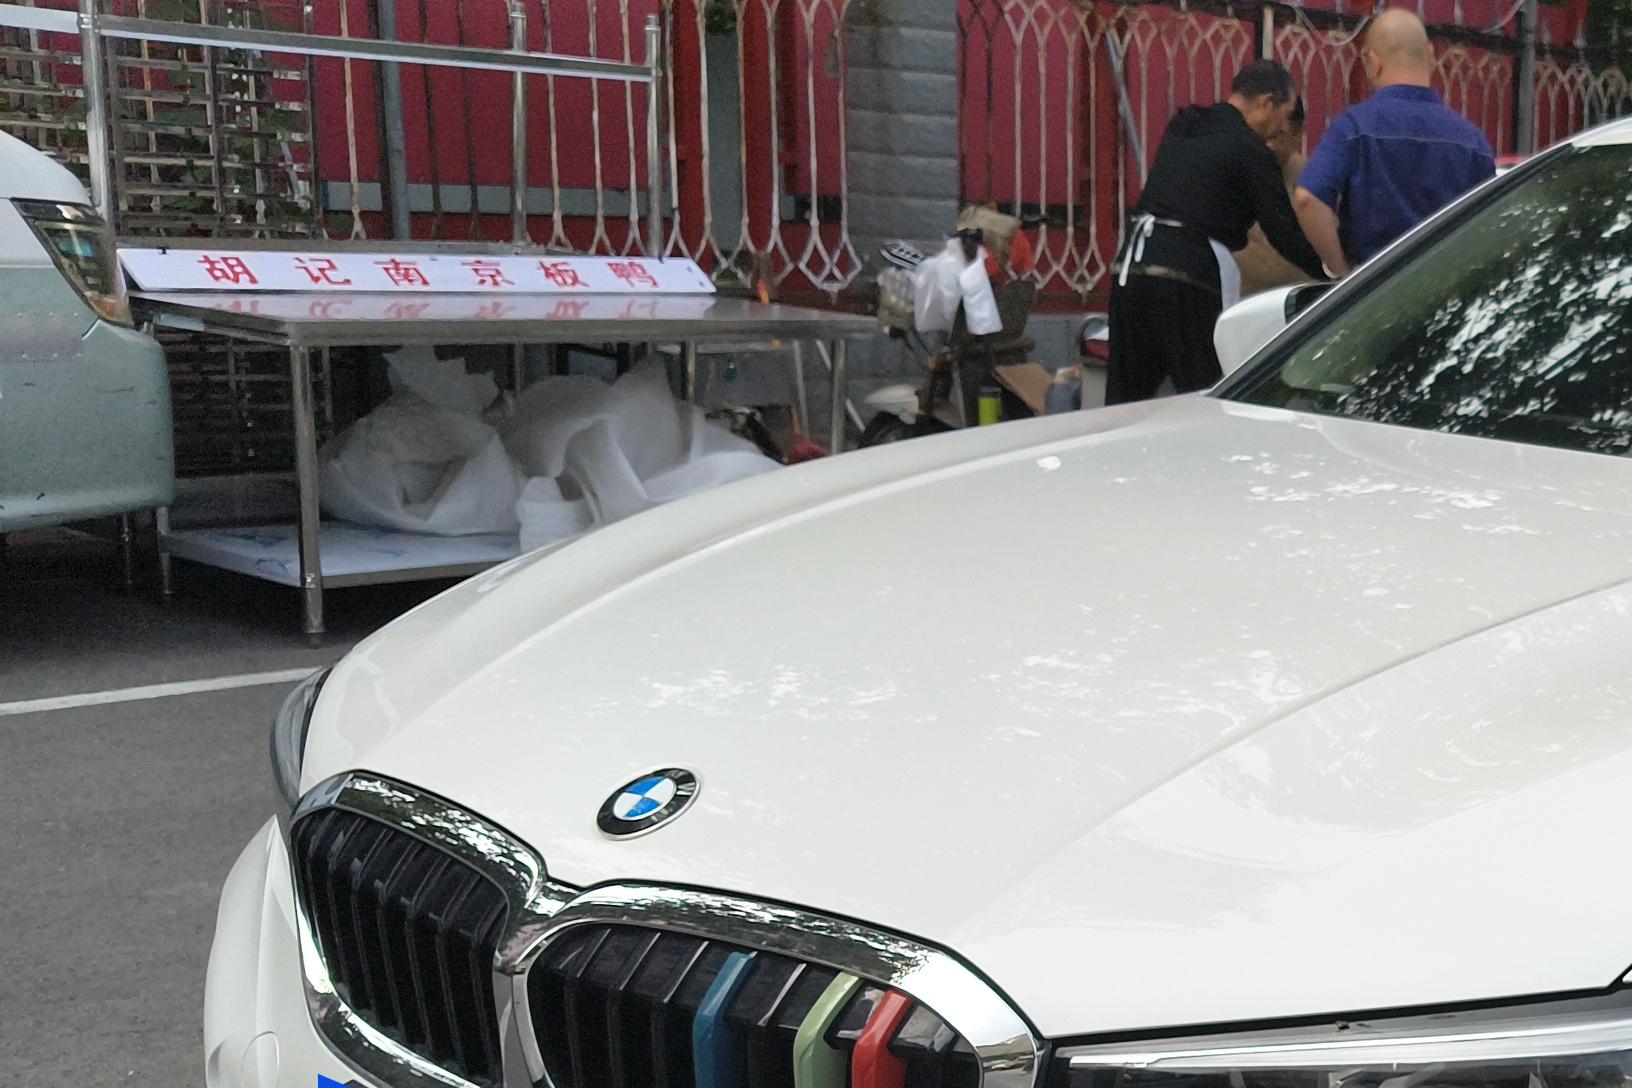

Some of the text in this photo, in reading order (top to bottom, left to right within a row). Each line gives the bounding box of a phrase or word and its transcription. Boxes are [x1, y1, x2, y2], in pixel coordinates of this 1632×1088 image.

[196, 255, 660, 289] 胡记南京板鸭
